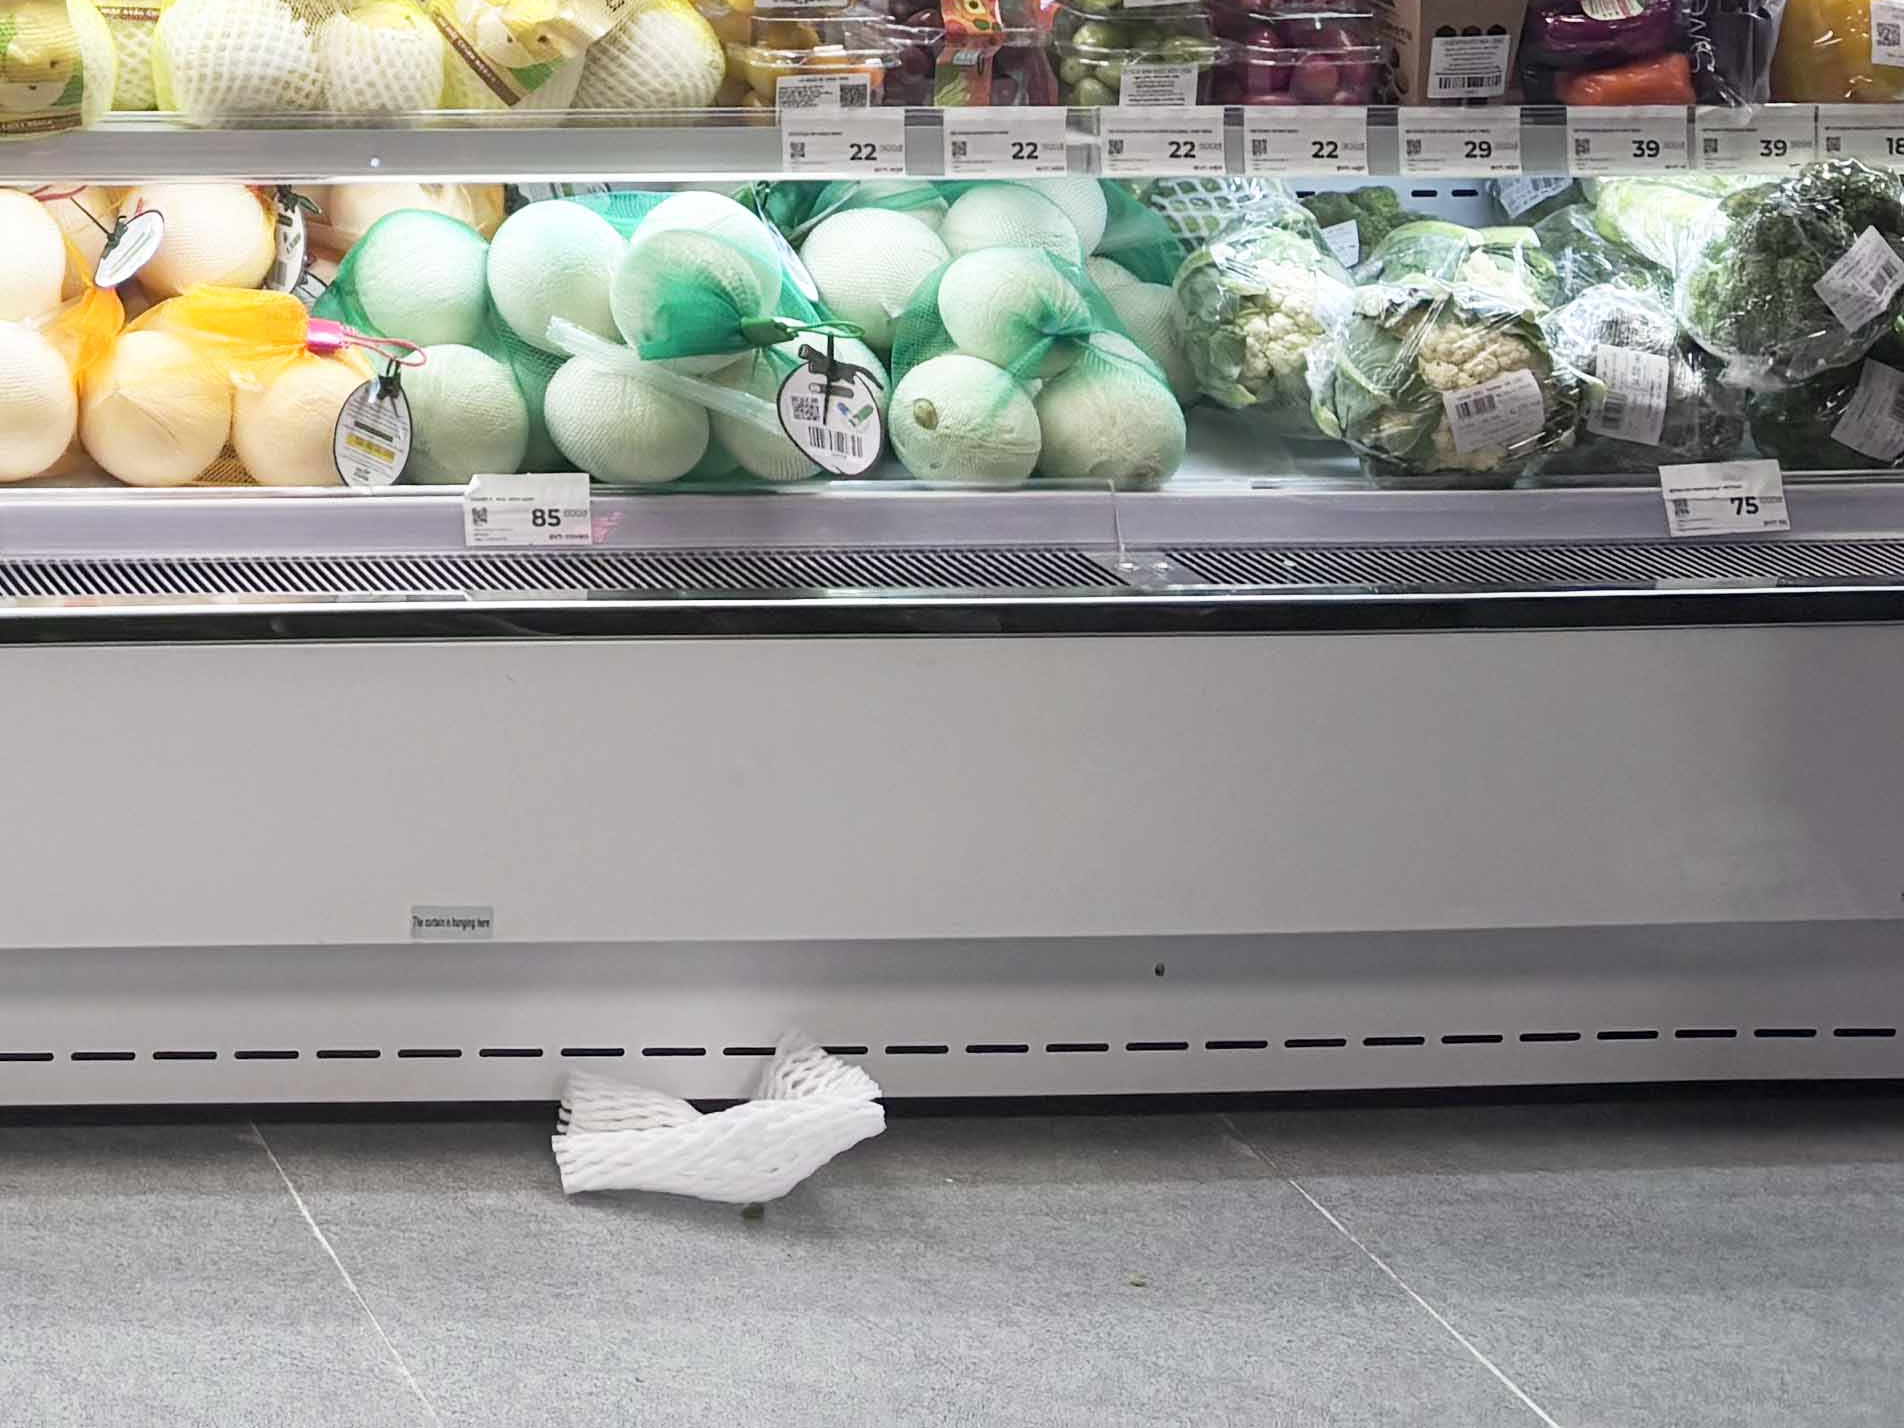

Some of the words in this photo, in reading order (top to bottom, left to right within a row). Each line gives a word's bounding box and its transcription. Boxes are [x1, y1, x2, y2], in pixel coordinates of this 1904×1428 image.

[849, 143, 877, 161] 22
[1011, 142, 1039, 160] 22
[1168, 141, 1196, 159] 22
[1311, 141, 1338, 159] 22
[1463, 140, 1492, 159] 29
[1632, 139, 1660, 159] 39
[1759, 139, 1788, 157] 39
[1729, 496, 1759, 516] 75
[531, 508, 561, 527] 85
